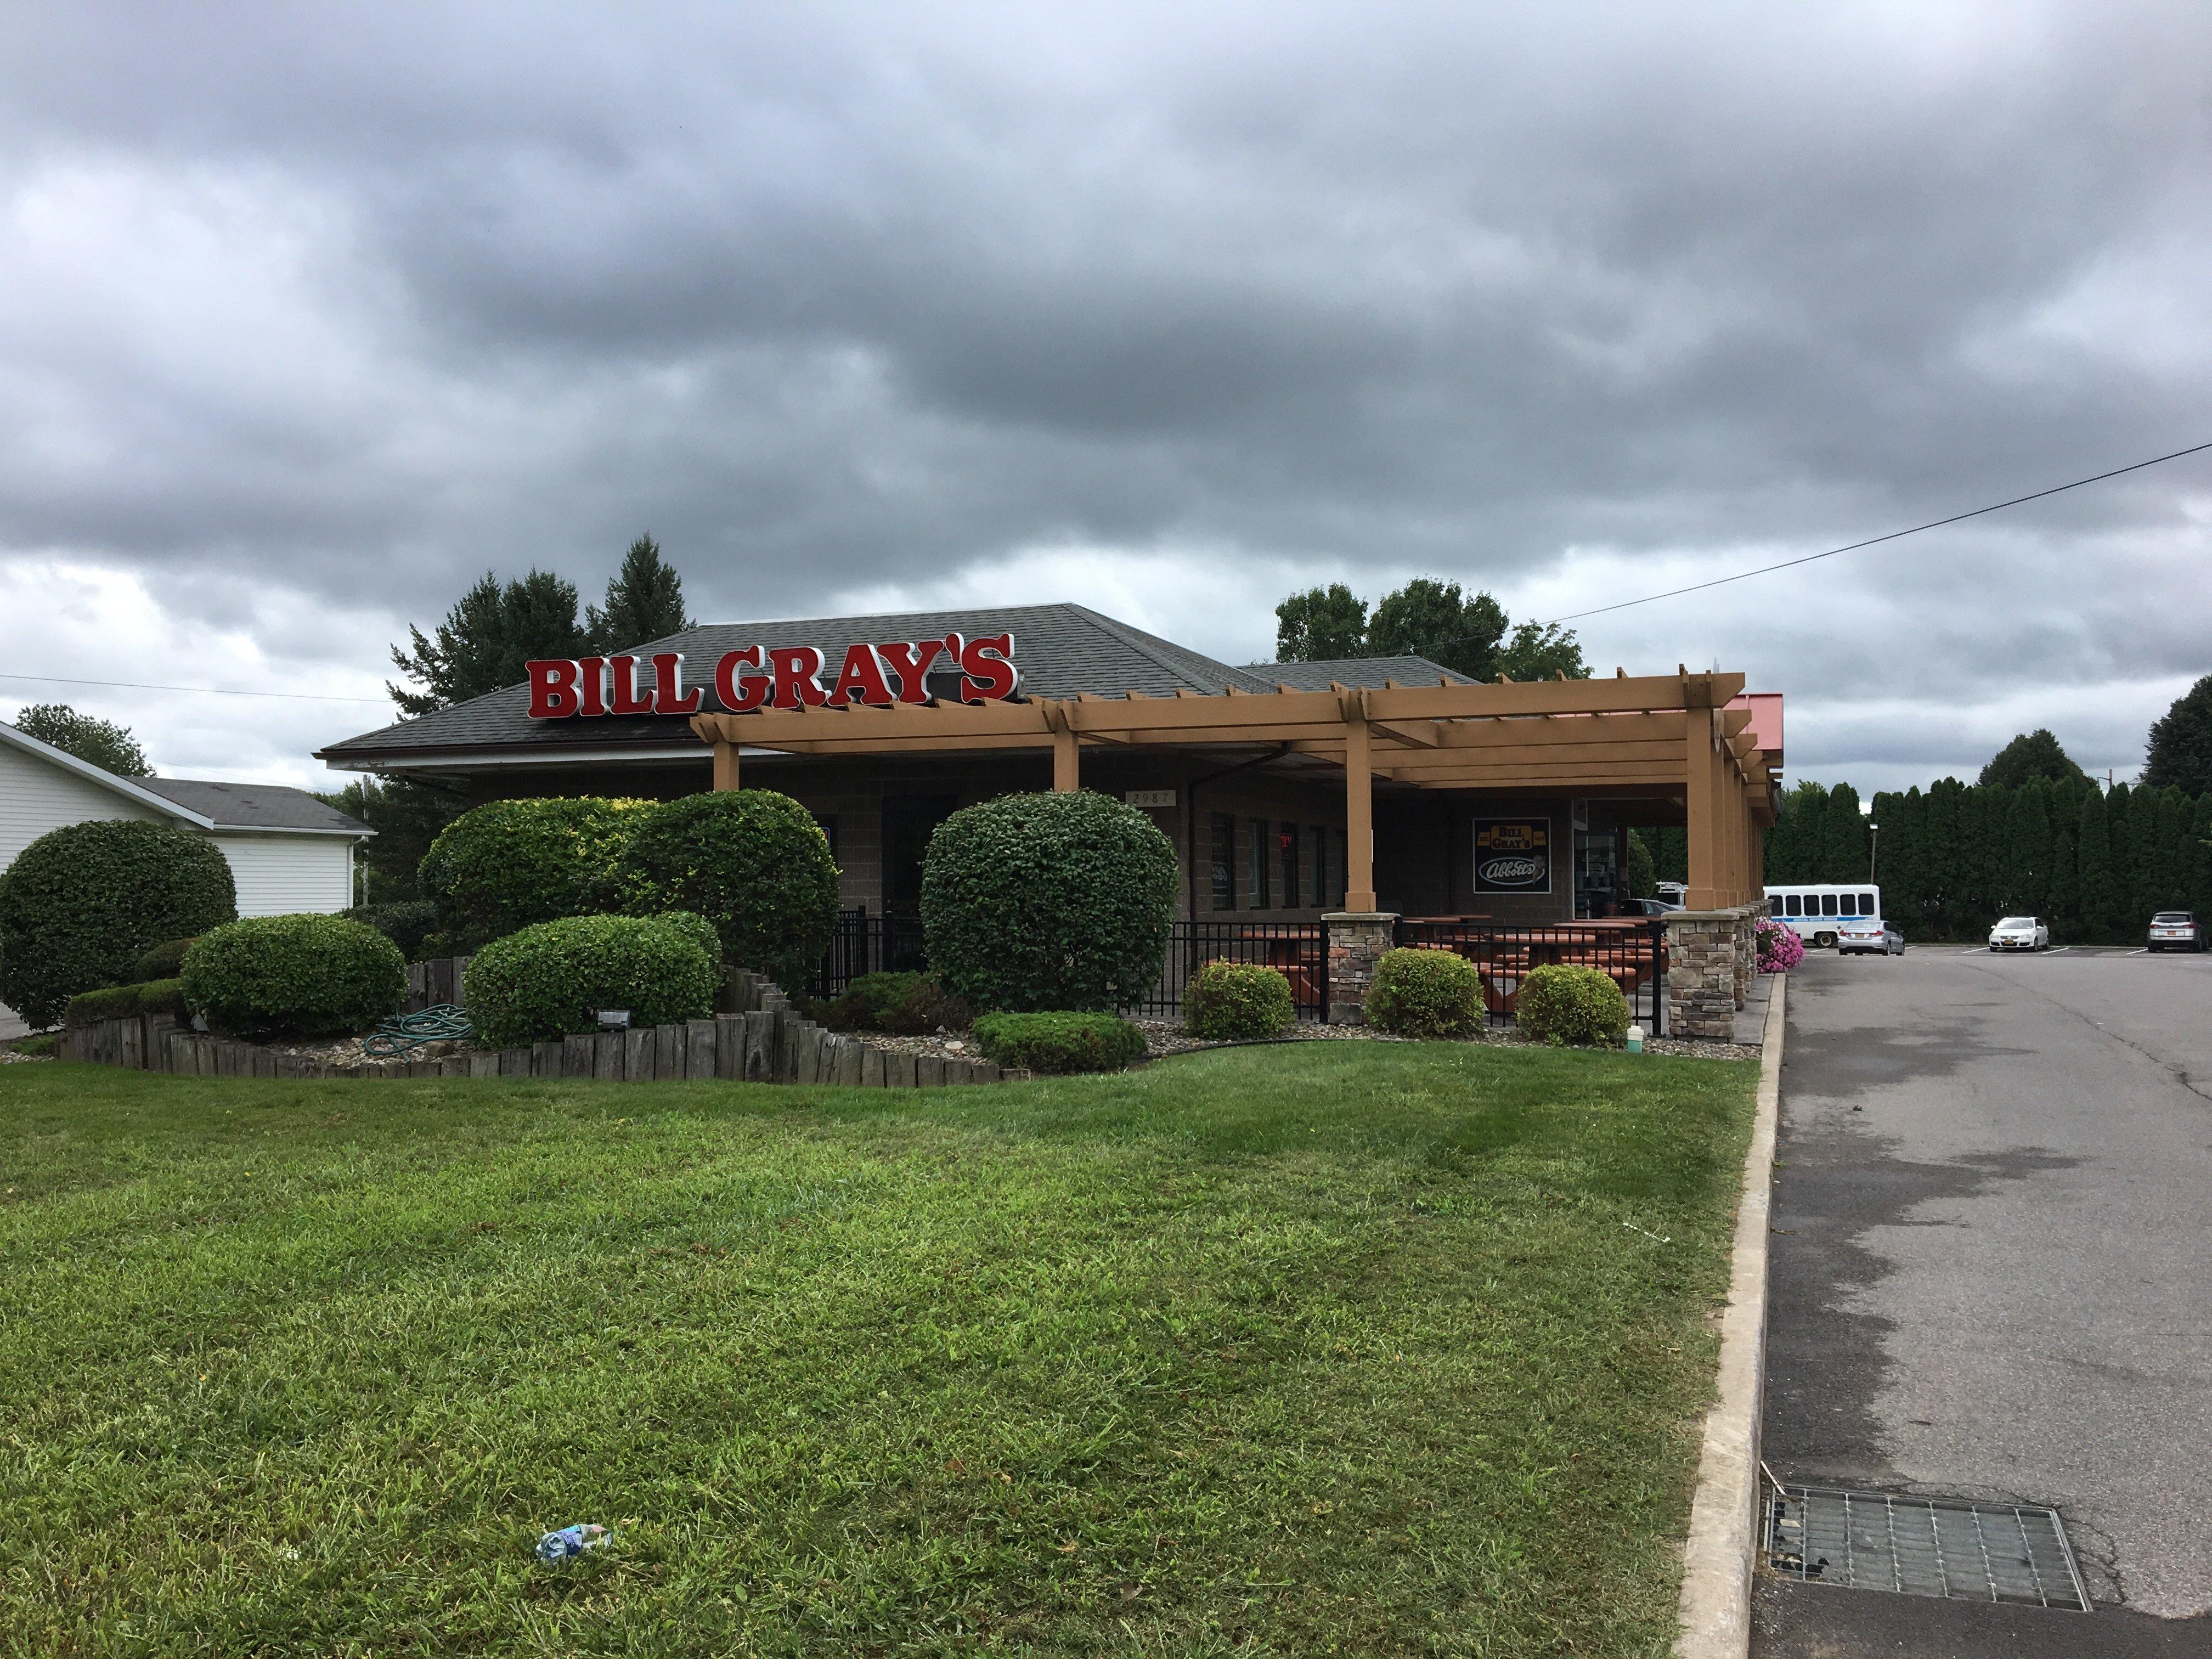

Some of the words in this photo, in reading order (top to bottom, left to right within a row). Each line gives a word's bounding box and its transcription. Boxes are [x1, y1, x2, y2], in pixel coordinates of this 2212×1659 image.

[525, 652, 704, 719] BILL
[714, 632, 1018, 712] GRAY'S
[1133, 793, 1169, 804] 2987
